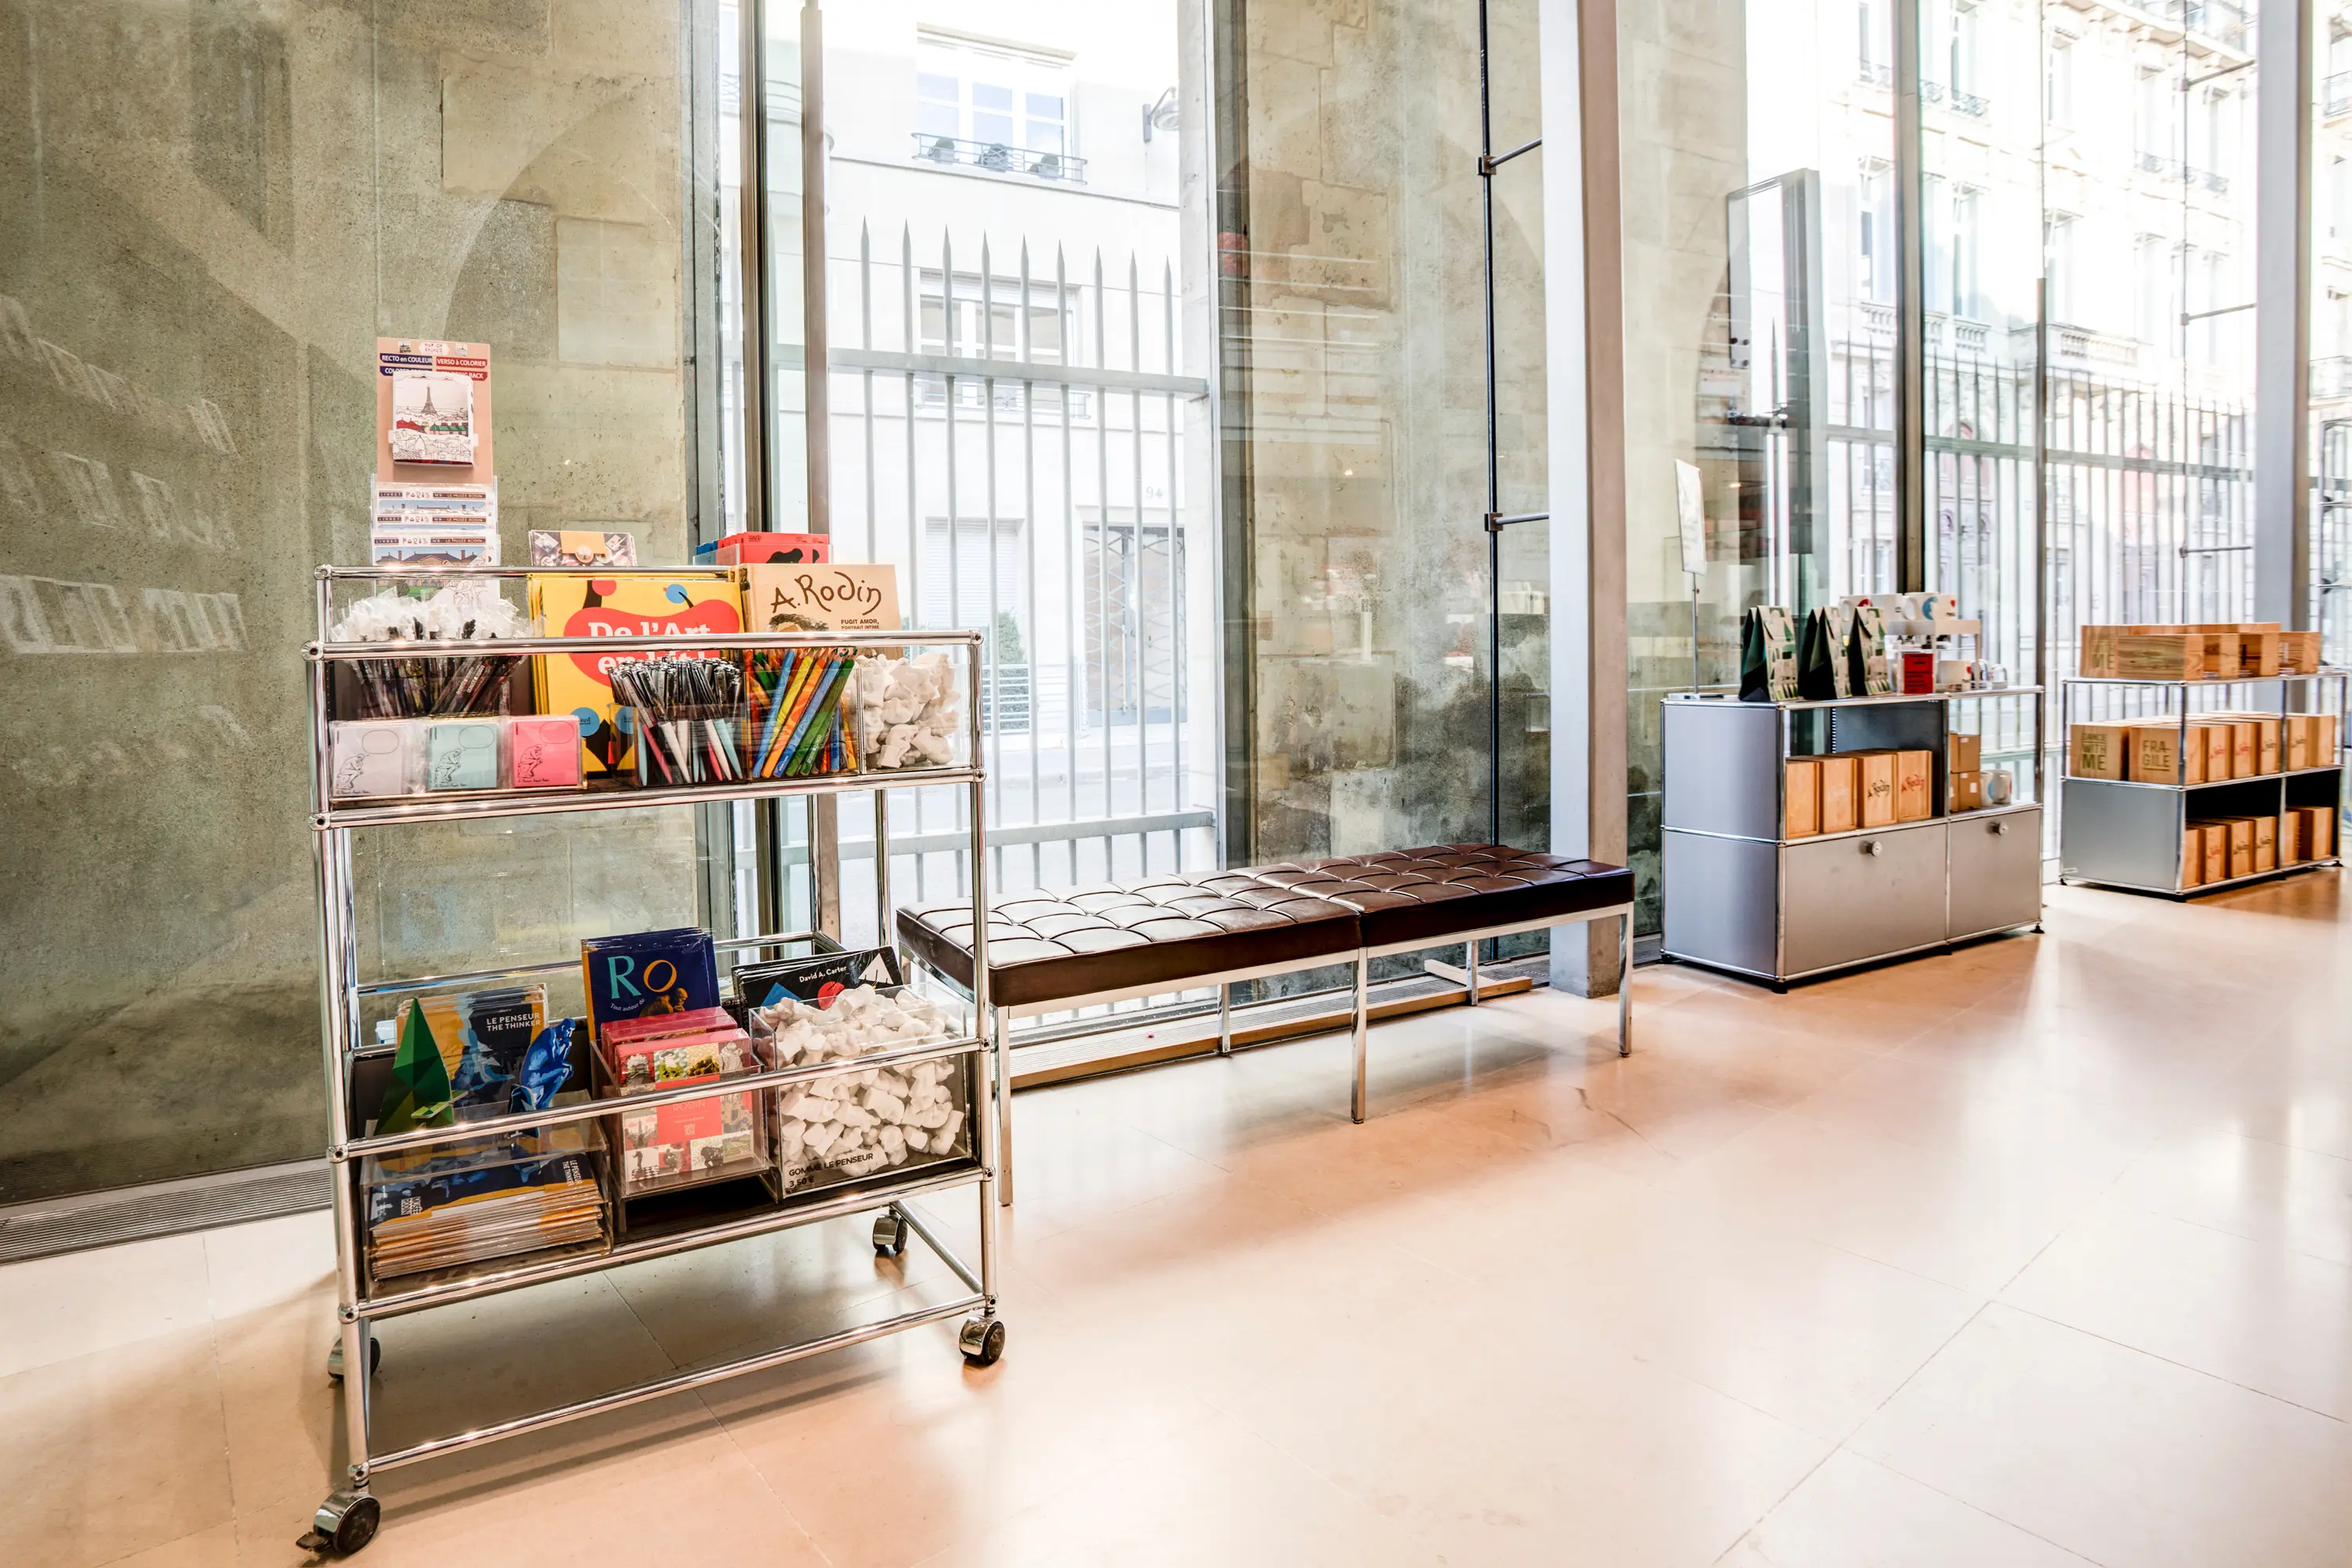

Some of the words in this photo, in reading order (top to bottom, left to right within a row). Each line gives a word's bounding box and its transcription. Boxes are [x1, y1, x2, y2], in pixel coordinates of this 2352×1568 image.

[1145, 486, 1163, 500] 94
[2143, 740, 2171, 753] FRA-
[2082, 754, 2107, 770] ME
[2143, 754, 2170, 768] GILE
[799, 971, 818, 983] David
[826, 966, 847, 975] Carter
[610, 1003, 622, 1011] Tout
[499, 1012, 540, 1023] PENSEUR
[506, 1020, 541, 1029] THINKER
[673, 1100, 705, 1111] RODIN
[789, 1163, 822, 1176] GOMME
[824, 1160, 834, 1170] LE
[836, 1153, 873, 1167] PENSEUR
[564, 1169, 574, 1186] THINKER
[571, 1165, 583, 1185] PENSEUR
[789, 1178, 807, 1188] 3,50
